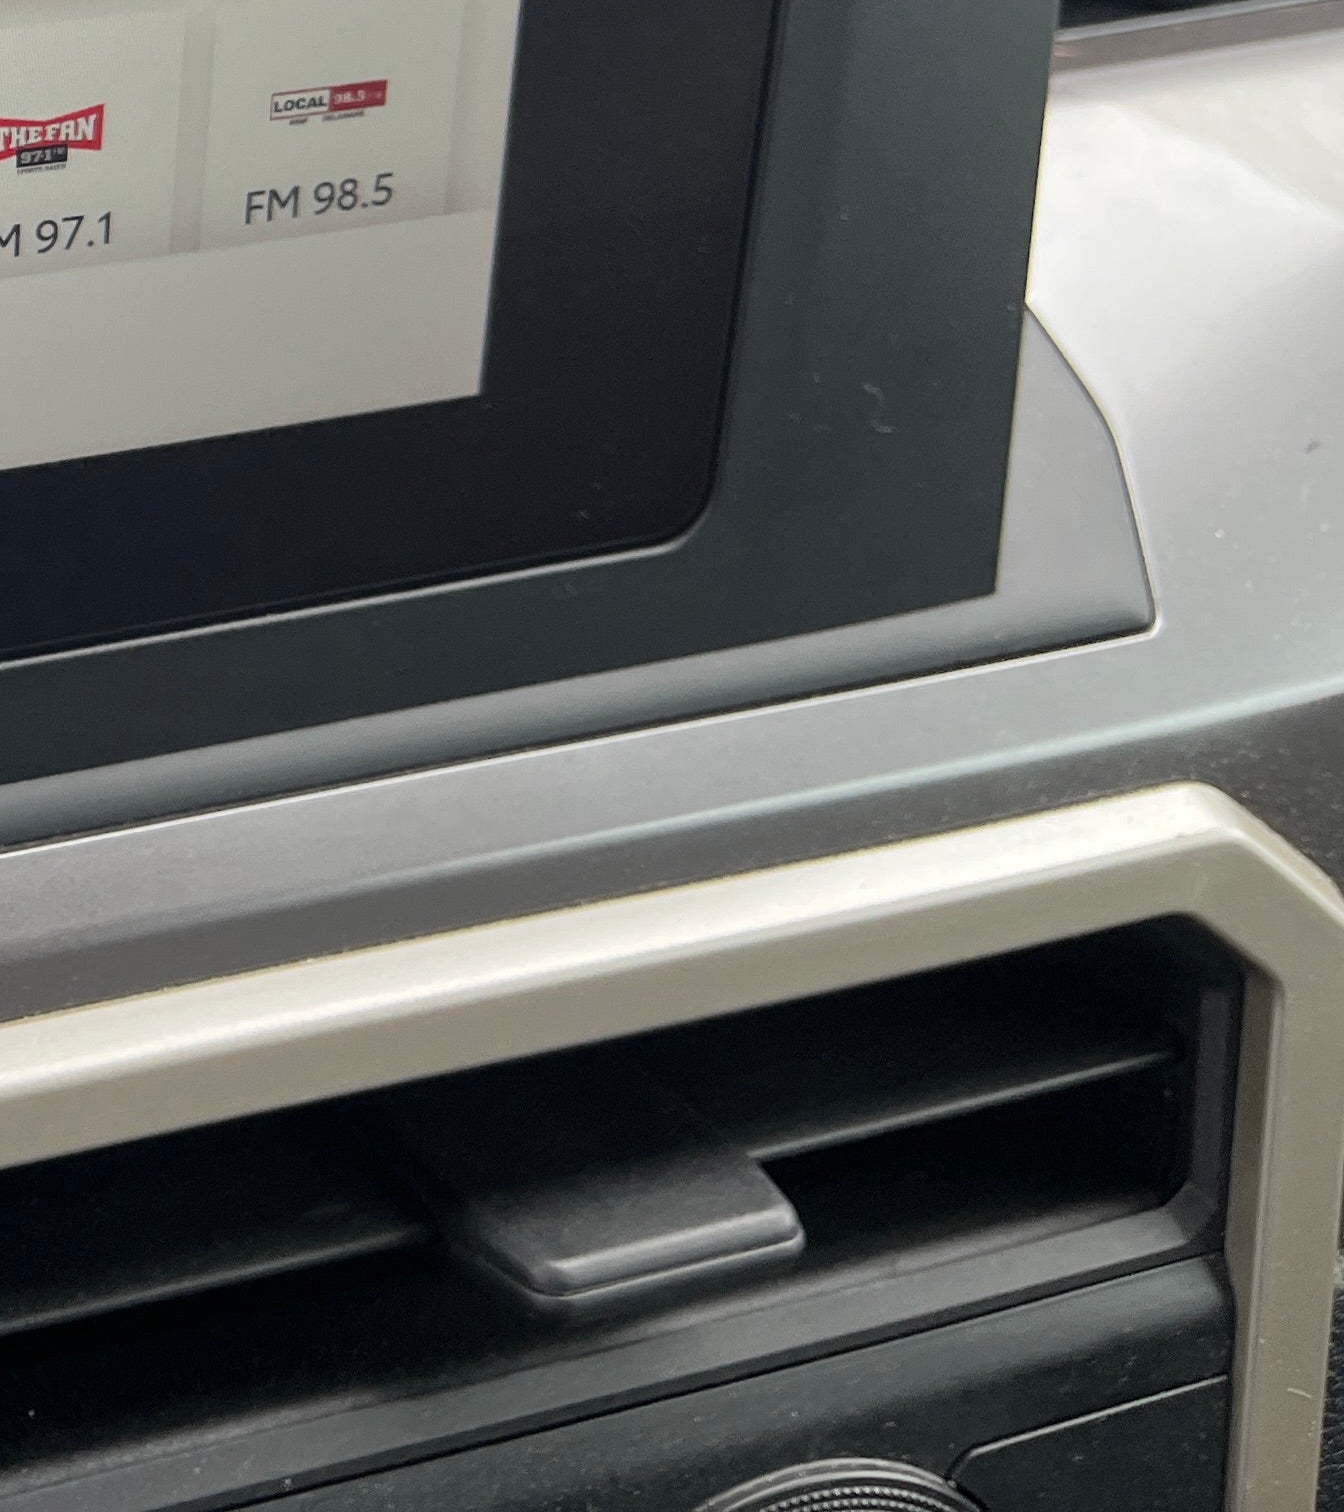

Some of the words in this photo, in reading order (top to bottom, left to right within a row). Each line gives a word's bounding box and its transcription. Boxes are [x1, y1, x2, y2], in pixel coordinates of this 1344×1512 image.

[273, 95, 327, 113] LOCAL
[44, 113, 97, 142] FAN
[245, 185, 300, 225] FM
[313, 172, 394, 215] 98.5
[35, 211, 113, 254] 97.1
